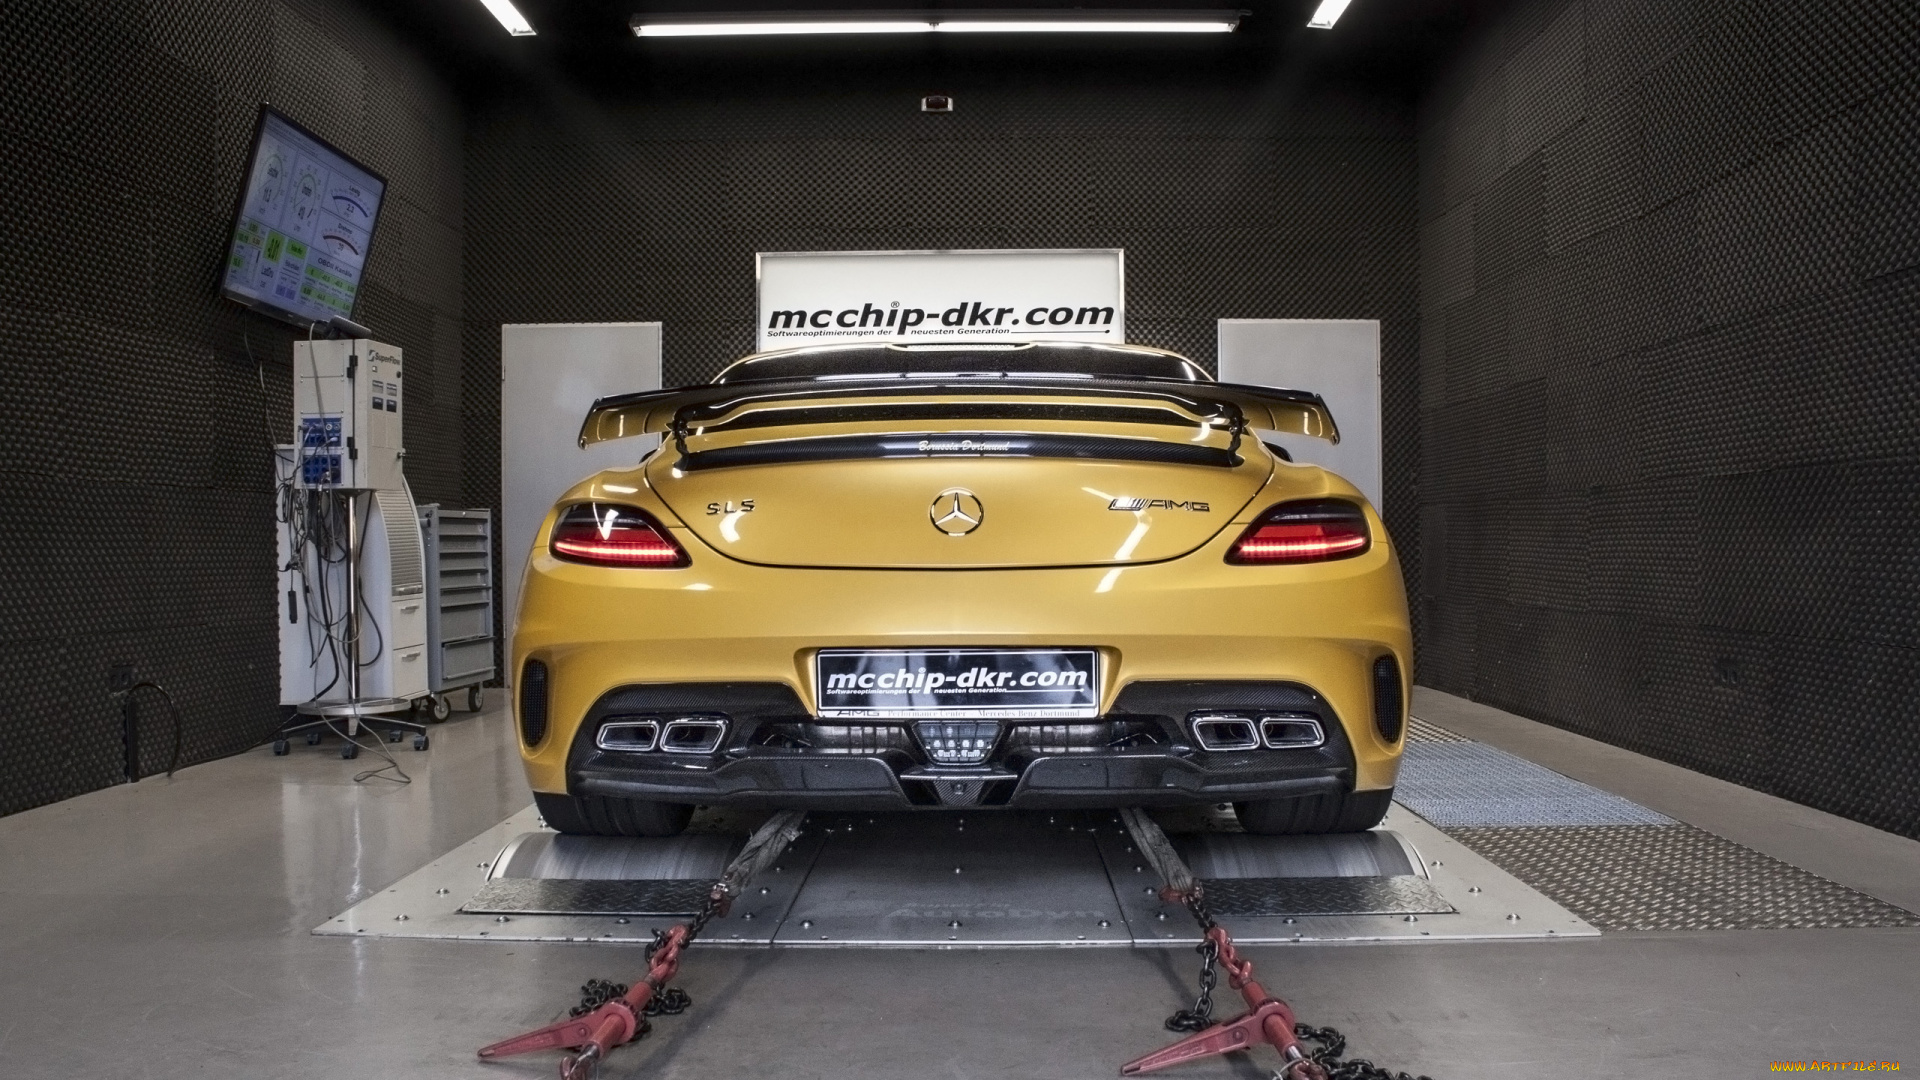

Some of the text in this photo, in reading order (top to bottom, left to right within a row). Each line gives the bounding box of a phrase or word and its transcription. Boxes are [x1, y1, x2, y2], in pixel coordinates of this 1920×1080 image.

[767, 330, 874, 338] Softwareoptimierungen
[957, 327, 1010, 335] Generation
[375, 352, 401, 366] SuperFlow
[706, 499, 756, 515] SLS
[1147, 499, 1211, 513] AMG
